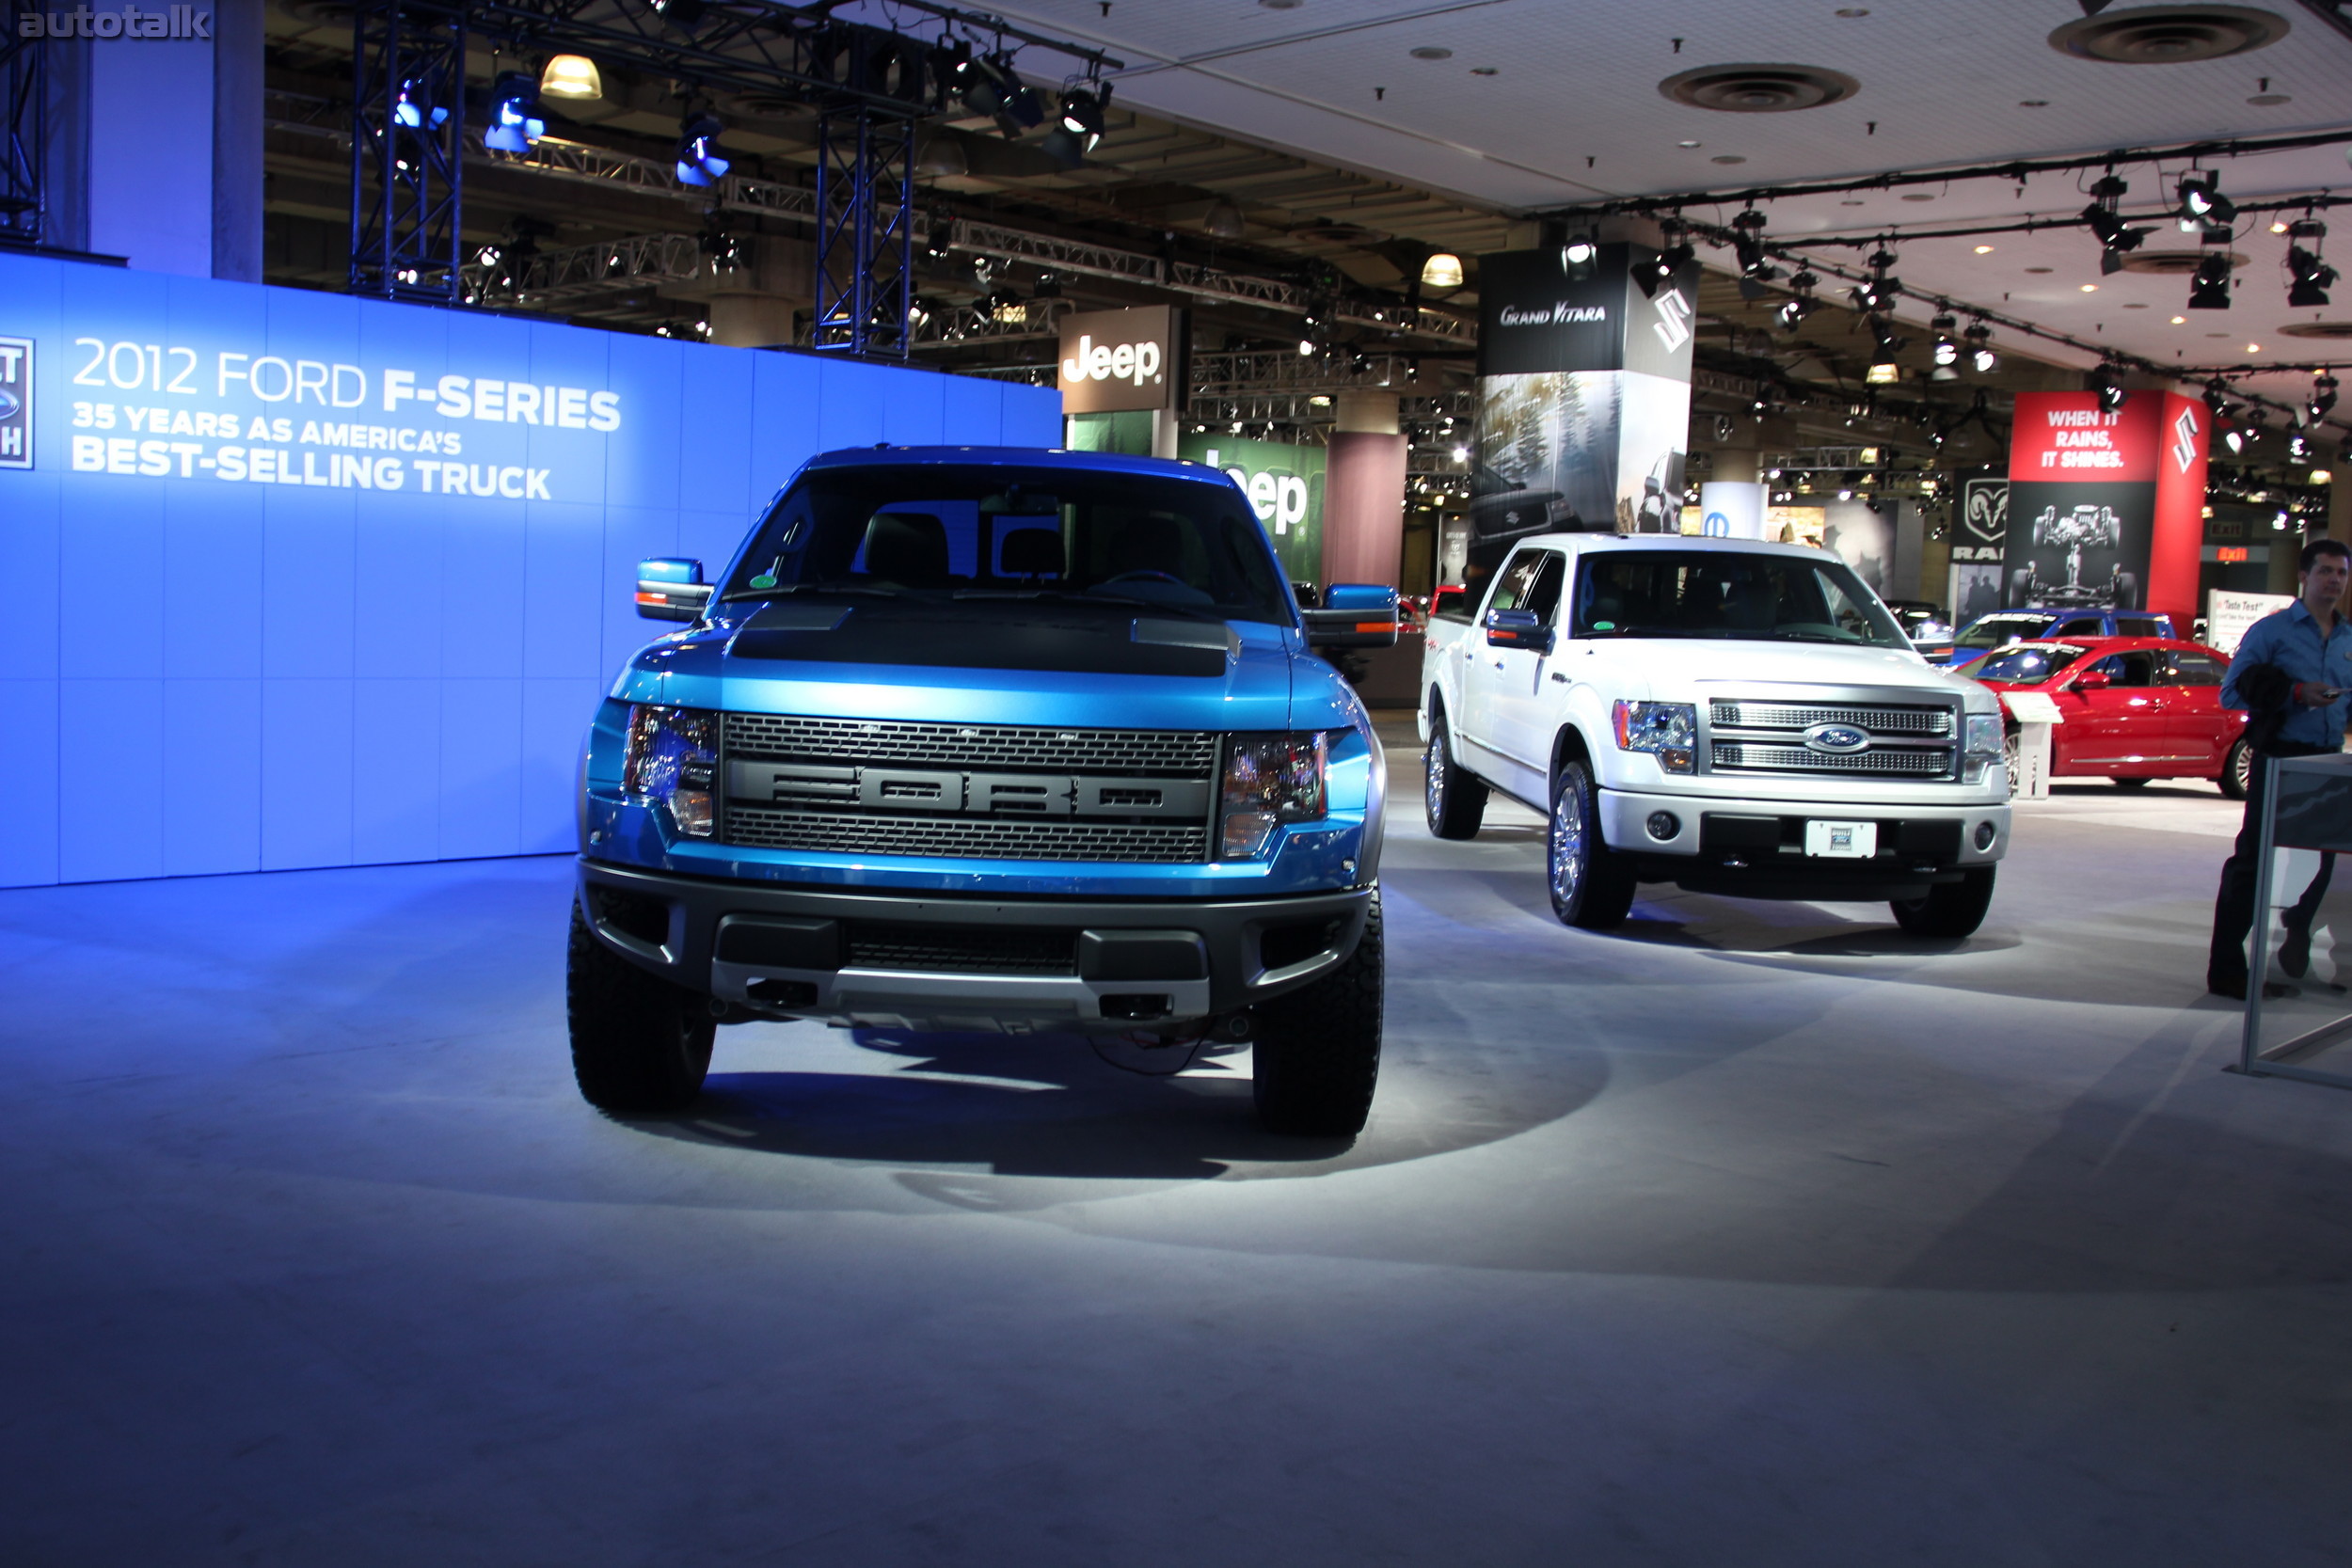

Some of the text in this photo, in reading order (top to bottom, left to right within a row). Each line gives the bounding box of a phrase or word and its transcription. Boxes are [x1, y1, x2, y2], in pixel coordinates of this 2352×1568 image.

[72, 337, 621, 432] 2012 FORD F-SERIES
[1063, 335, 1160, 387] Jeep
[72, 402, 462, 455] 35 YEARS AS AMERICA'S
[2047, 410, 2100, 427] WHEN
[2056, 431, 2113, 450] RAINS,
[72, 435, 552, 500] BEST-SELLING TRUCK
[2042, 451, 2124, 467] IT SHINES.
[724, 758, 1211, 817] FORD
